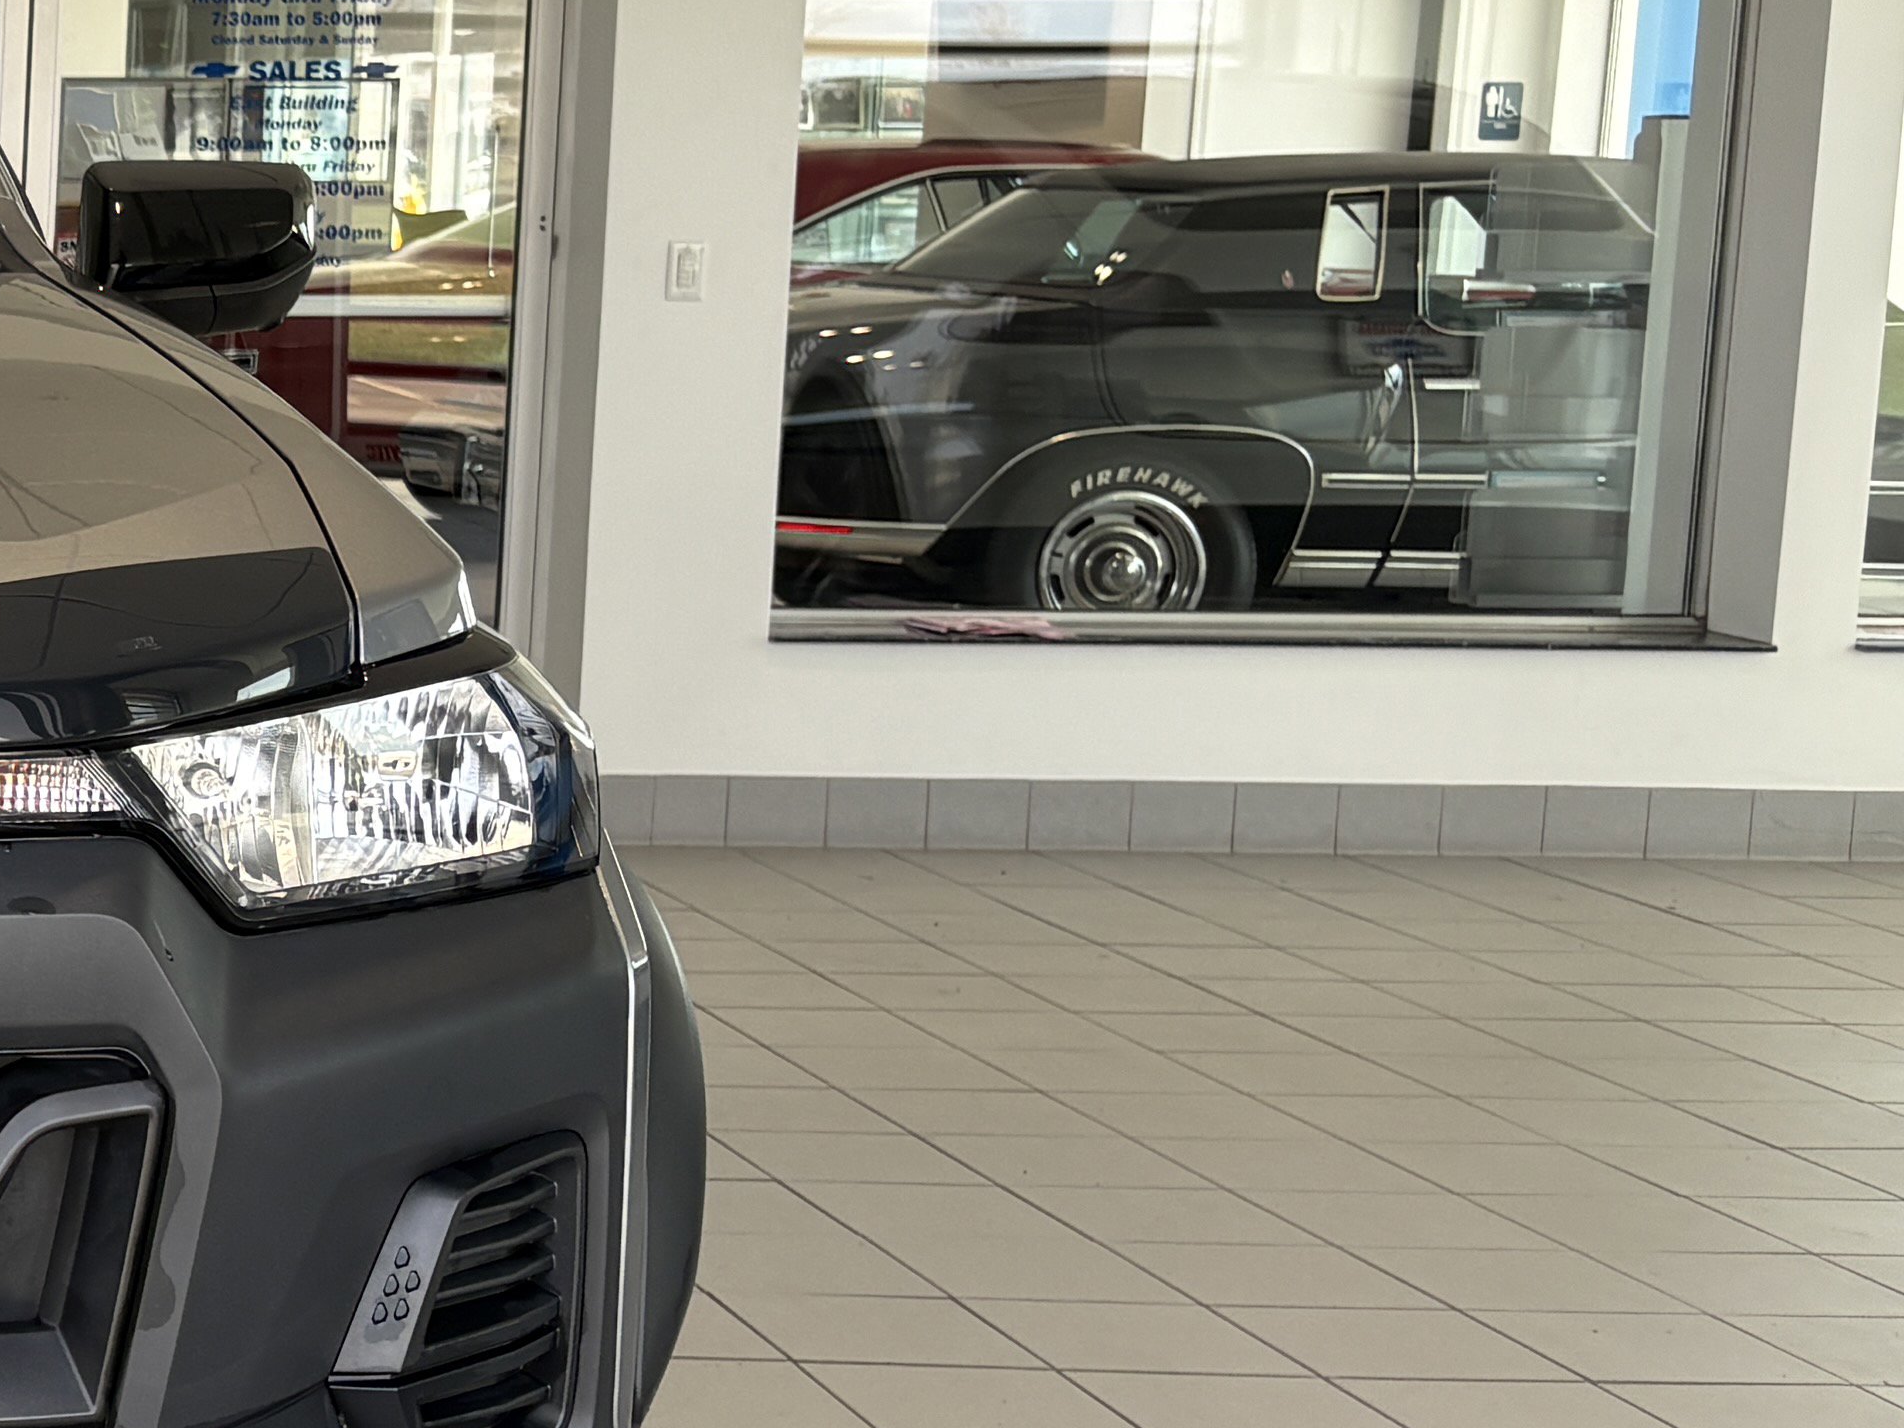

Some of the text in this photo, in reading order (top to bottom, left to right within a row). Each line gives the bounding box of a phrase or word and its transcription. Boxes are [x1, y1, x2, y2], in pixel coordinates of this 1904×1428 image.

[212, 12, 382, 29] 7:30am to 5:00pm
[211, 34, 380, 47] Closed Saturday & Sunday
[249, 60, 342, 81] SALES
[279, 95, 359, 114] Building
[255, 119, 323, 132] Monday
[196, 136, 387, 154] 9:00am to 8:00pm
[323, 160, 376, 174] Friday
[315, 181, 385, 199] :00pm
[318, 225, 383, 243] :00pm
[1070, 466, 1209, 509] FIREHAWK
